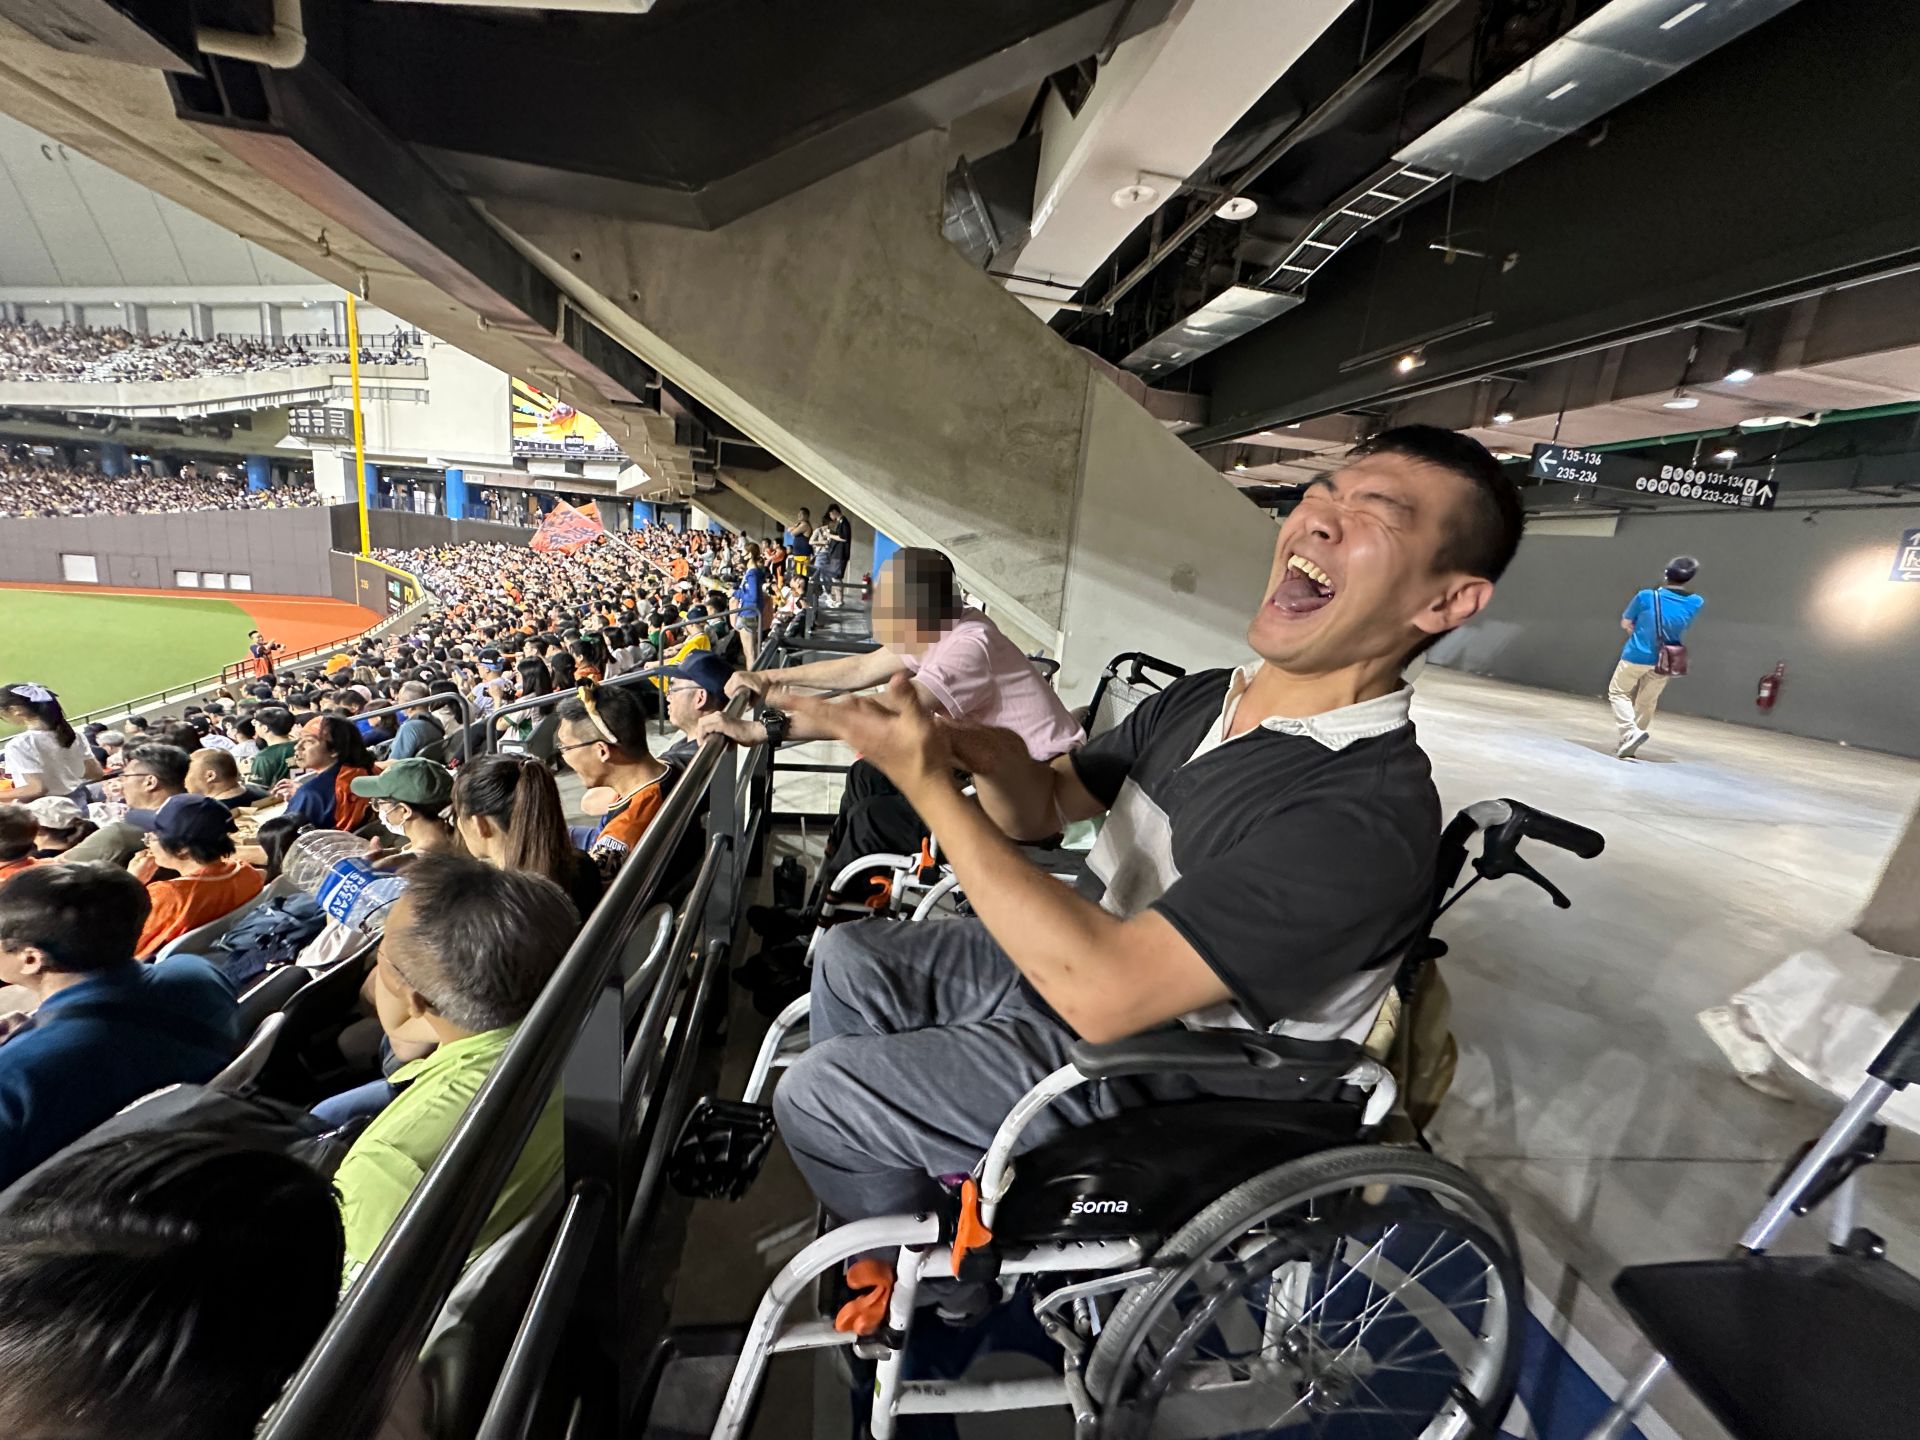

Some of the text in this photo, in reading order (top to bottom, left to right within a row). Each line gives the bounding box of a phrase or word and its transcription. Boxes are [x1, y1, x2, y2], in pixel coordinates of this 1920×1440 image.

[1562, 449, 1602, 465] 135-136
[1557, 467, 1598, 483] 235-236
[1707, 472, 1744, 488] 131-134
[1746, 480, 1755, 495] 6
[1701, 489, 1739, 505] 233-234
[330, 872, 360, 914] SWEAT
[1071, 1200, 1129, 1213] soma
